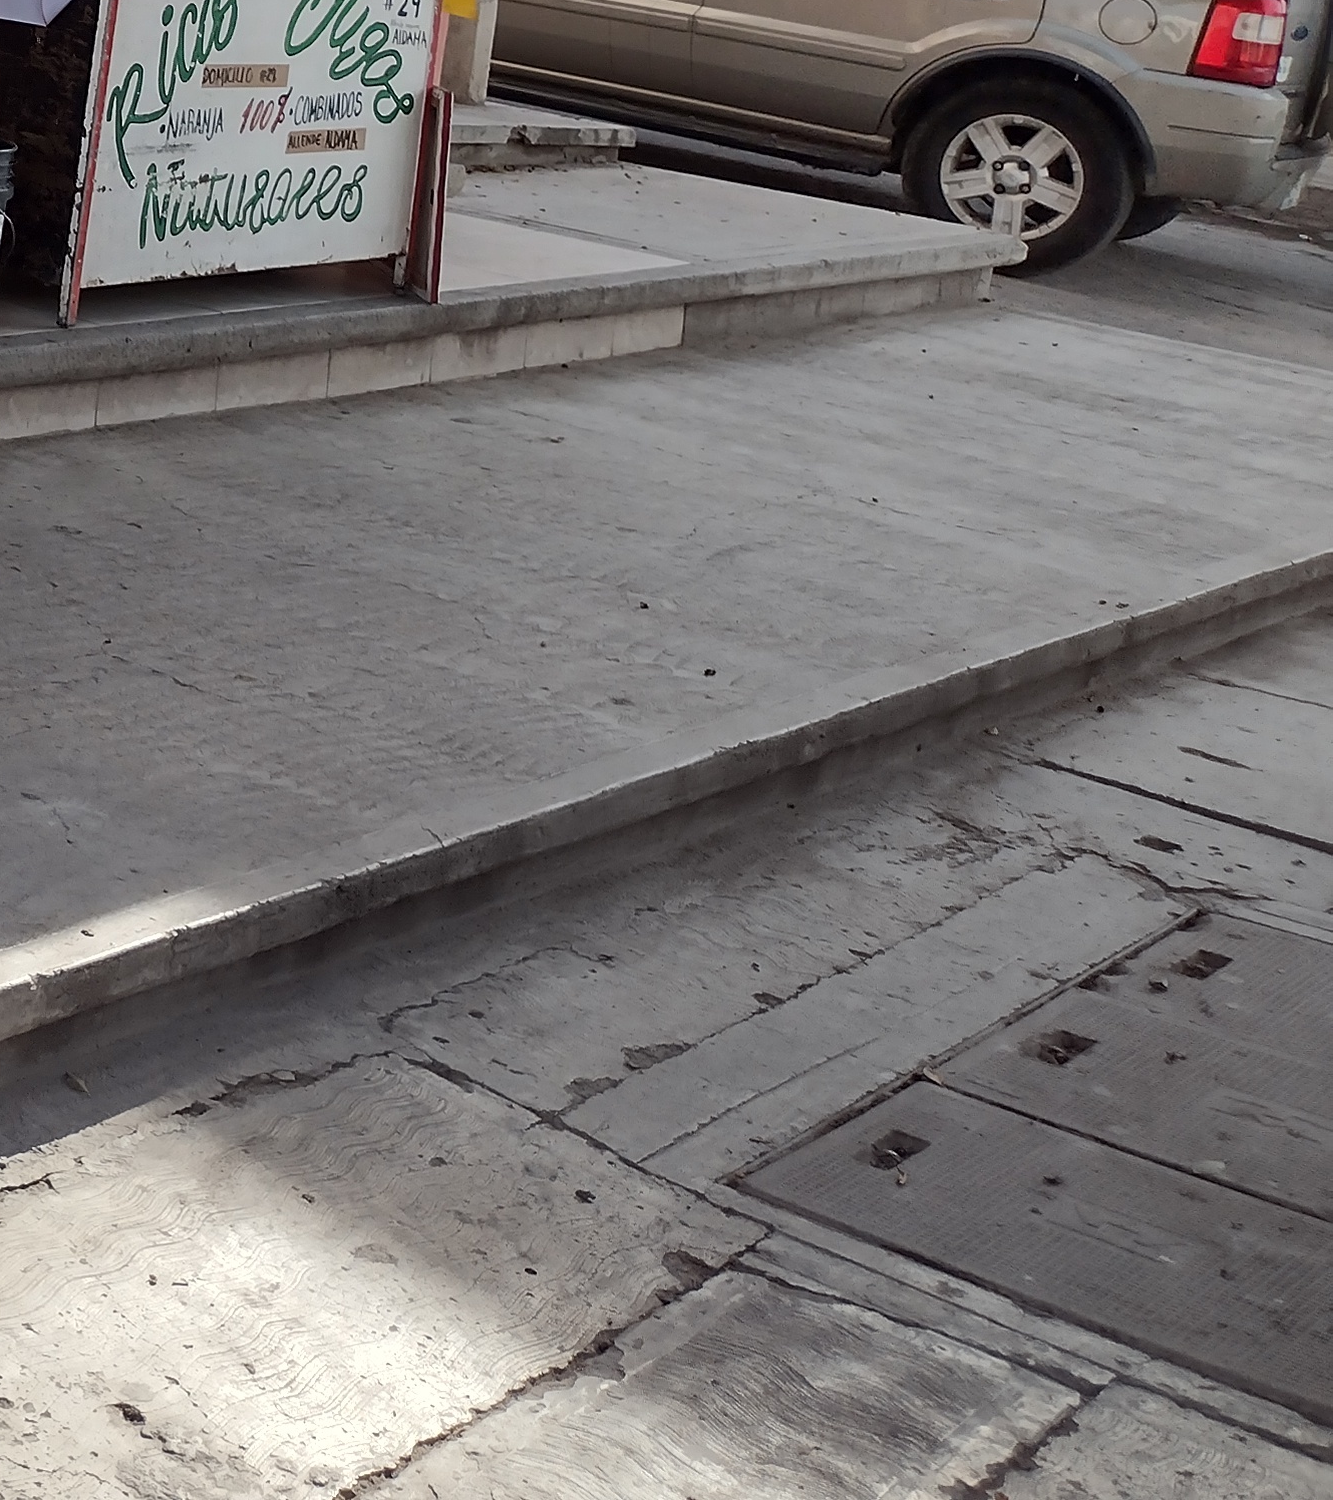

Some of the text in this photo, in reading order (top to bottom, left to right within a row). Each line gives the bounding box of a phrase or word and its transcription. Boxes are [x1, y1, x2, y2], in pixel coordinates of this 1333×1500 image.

[166, 106, 224, 141] NARANJA
[294, 91, 363, 126] COMBINADOS
[287, 132, 321, 149] ALLENDE
